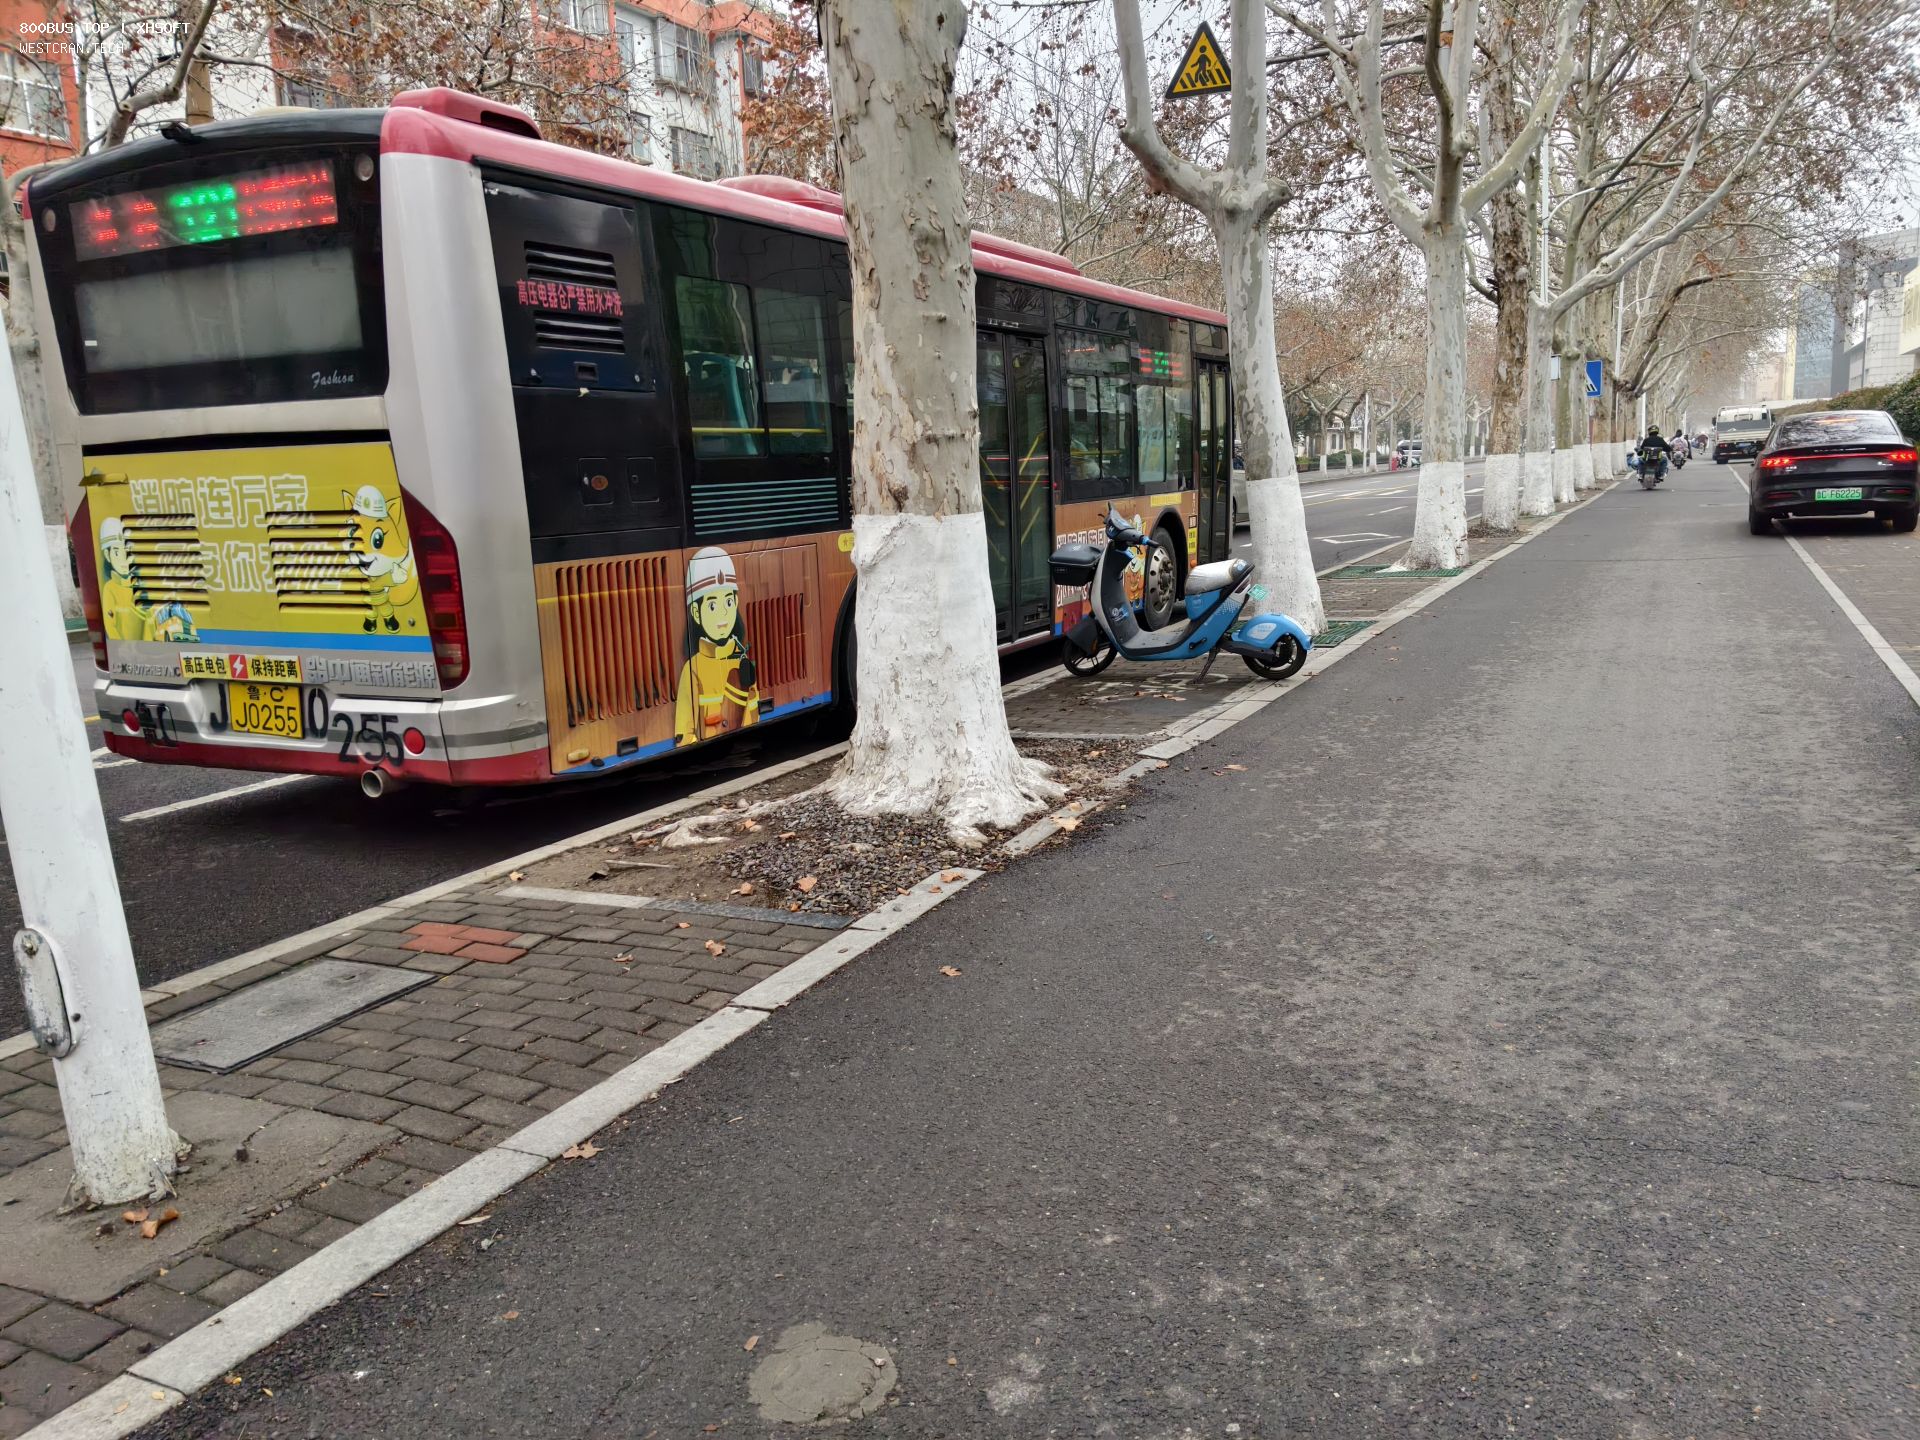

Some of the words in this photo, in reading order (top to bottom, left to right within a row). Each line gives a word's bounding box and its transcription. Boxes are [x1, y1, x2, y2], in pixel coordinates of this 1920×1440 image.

[516, 279, 623, 316] 高压电器仓严禁用水冲洗
[311, 369, 354, 389] Fashion
[184, 656, 226, 675] 高压电包
[251, 658, 298, 679] 保持距离
[235, 701, 298, 734] J0255
